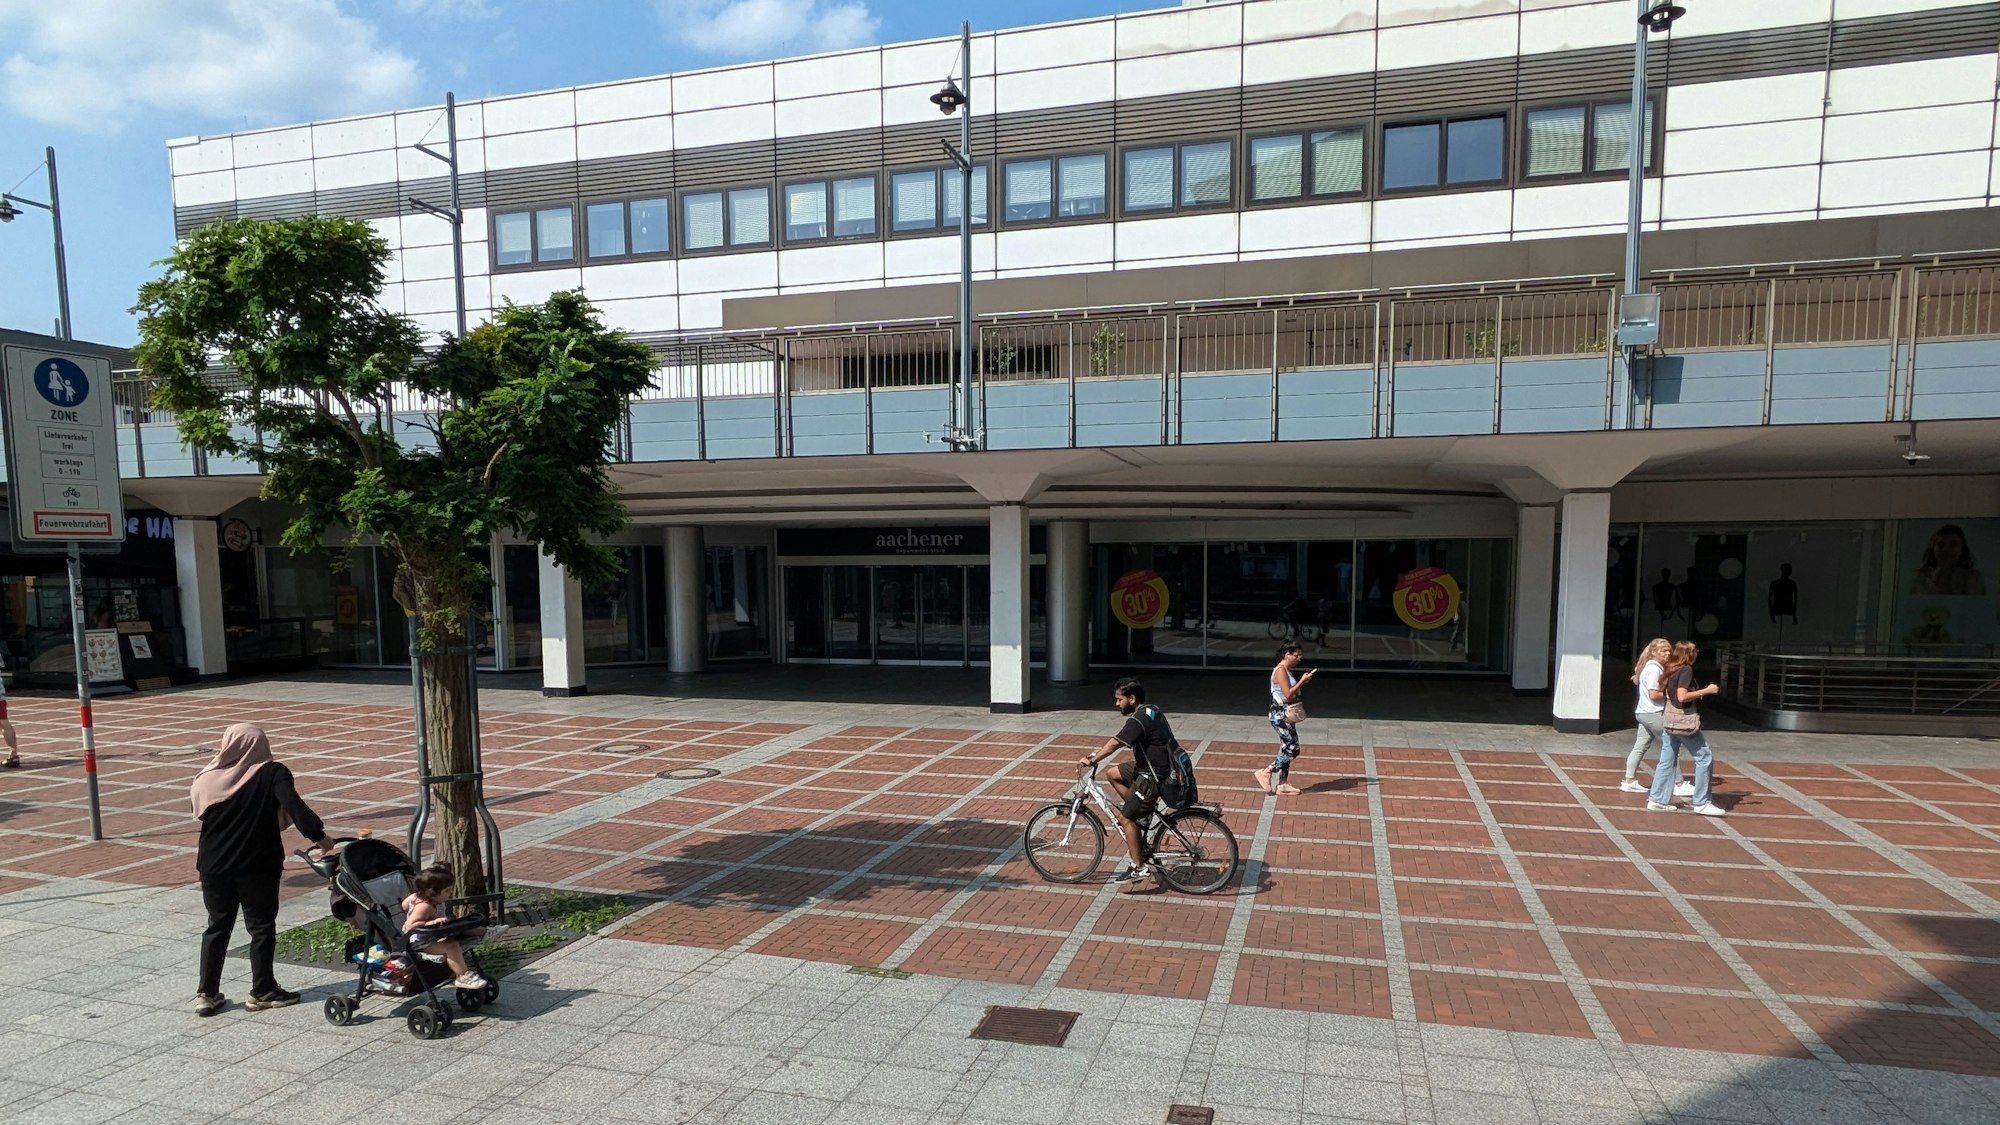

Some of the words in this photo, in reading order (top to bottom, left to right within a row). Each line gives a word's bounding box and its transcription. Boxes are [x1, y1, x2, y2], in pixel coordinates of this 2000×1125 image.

[50, 409, 79, 422] ZONE
[44, 431, 88, 441] Lieferverkehr
[62, 442, 74, 450] frei
[54, 459, 84, 467] werktags
[67, 499, 79, 507] frei
[39, 519, 107, 528] Feuerwehrzufahrt
[125, 517, 139, 535] E
[146, 516, 178, 539] HA
[875, 528, 964, 547] aachener
[1125, 588, 1155, 616] 30%
[1409, 586, 1443, 616] 30%
